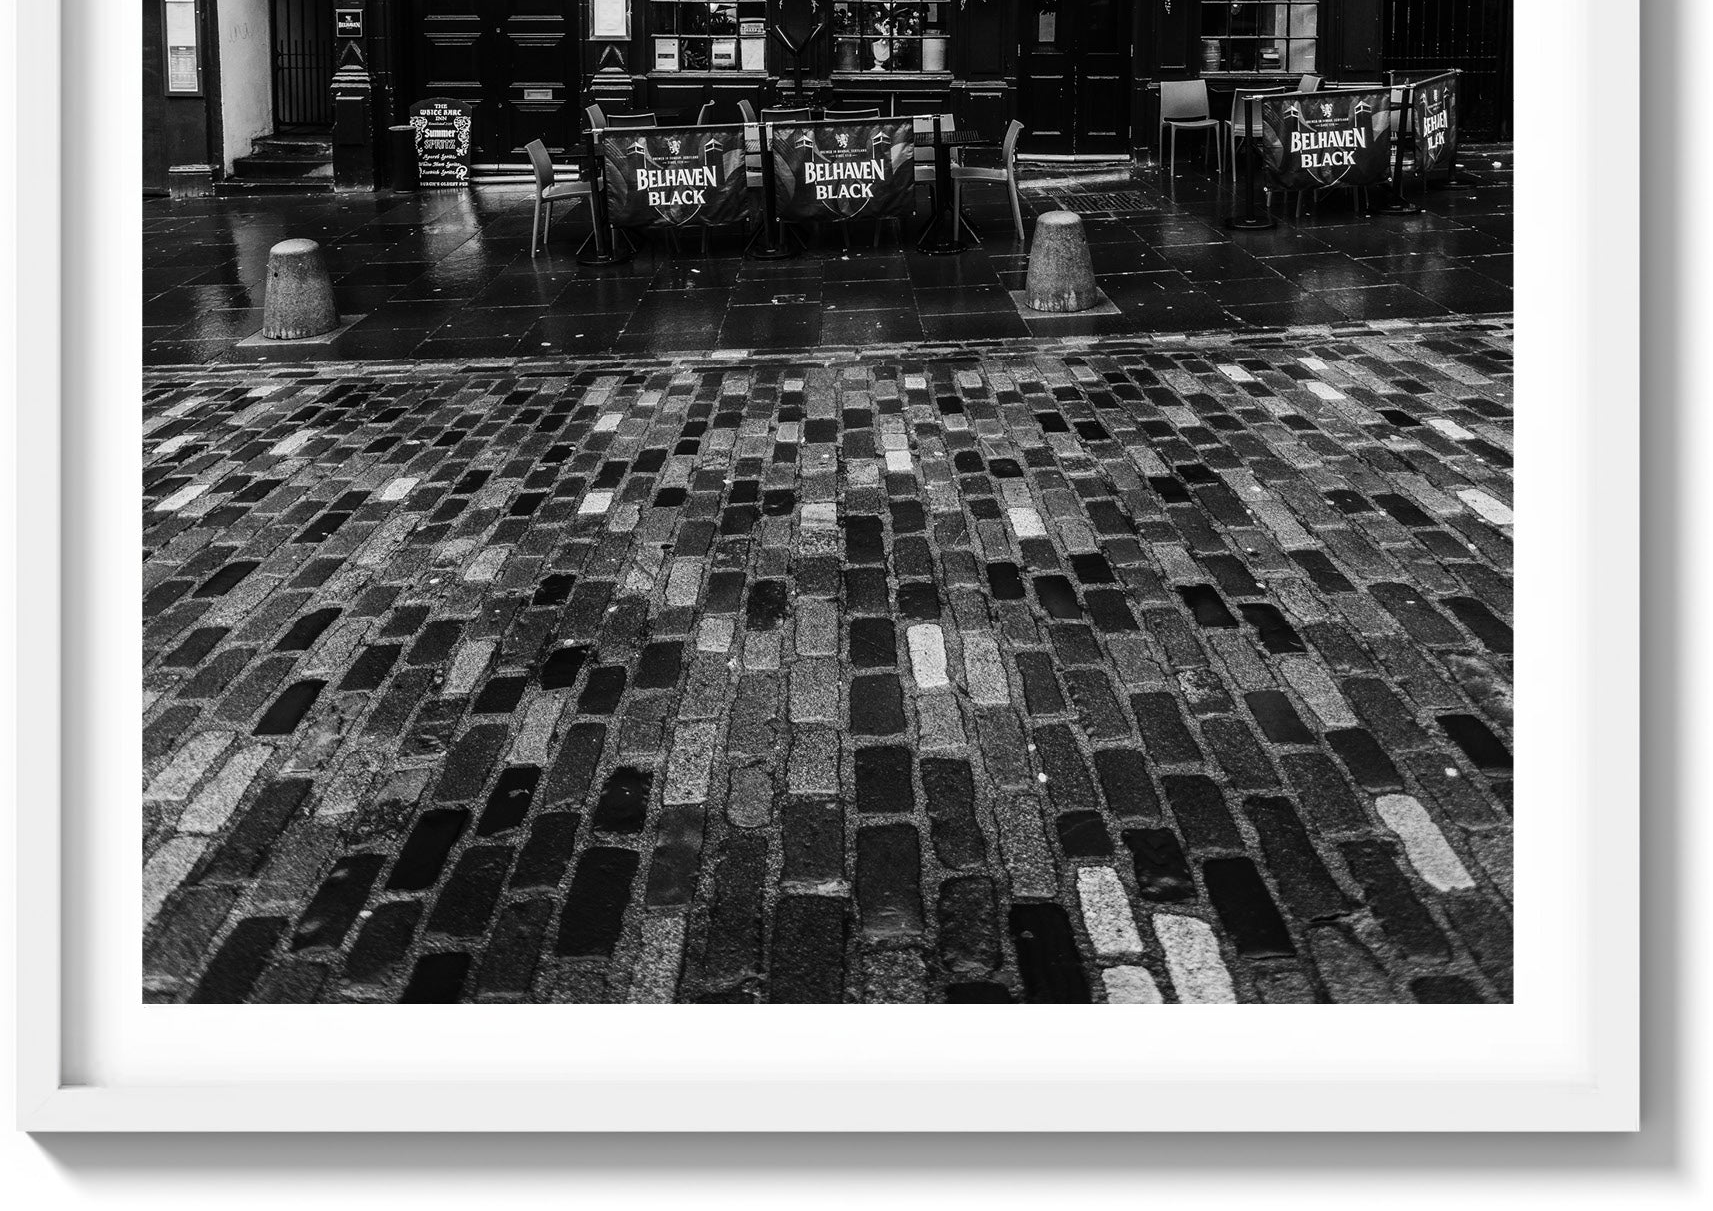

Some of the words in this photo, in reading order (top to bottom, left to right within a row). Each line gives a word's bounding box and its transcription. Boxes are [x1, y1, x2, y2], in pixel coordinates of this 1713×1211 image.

[424, 128, 456, 138] Summer
[1290, 127, 1366, 153] BELHAVEN
[1301, 150, 1356, 168] BLACK
[636, 165, 717, 191] BELHAVEN
[804, 159, 885, 184] BELHAVEN
[649, 189, 706, 206] BLACK
[815, 183, 874, 200] BLACK
